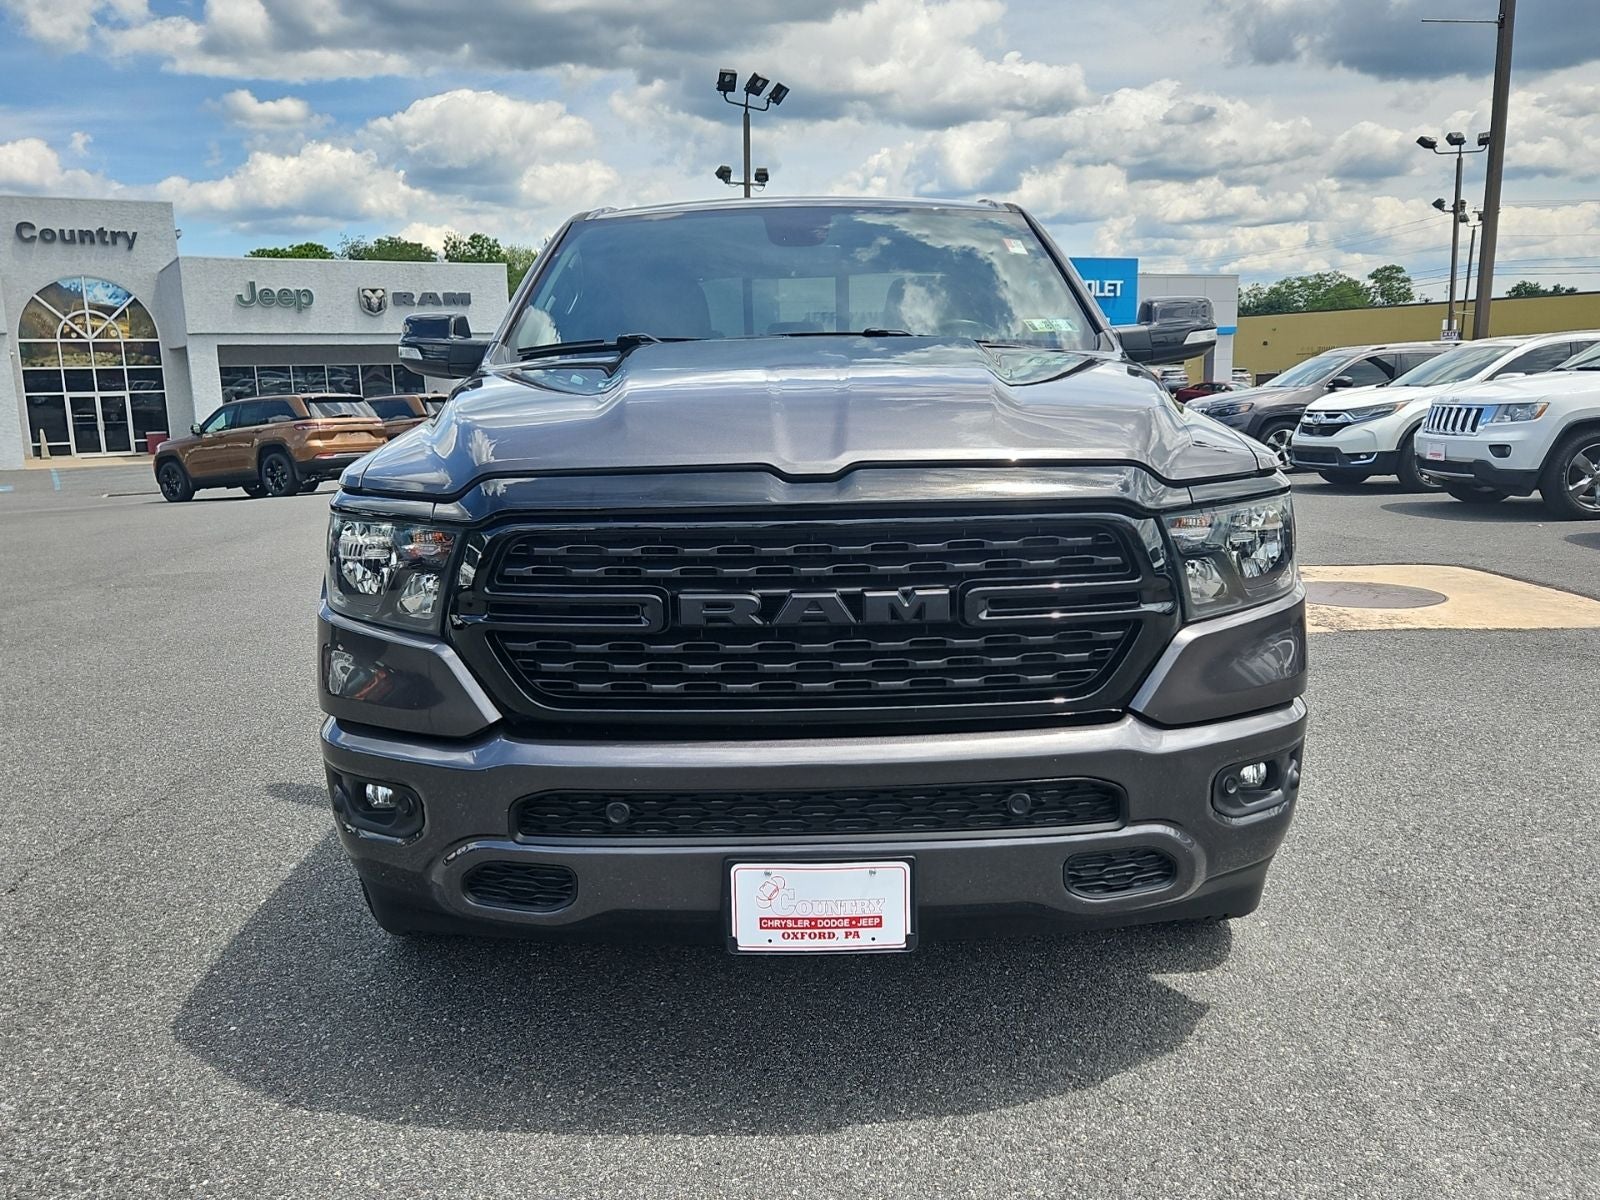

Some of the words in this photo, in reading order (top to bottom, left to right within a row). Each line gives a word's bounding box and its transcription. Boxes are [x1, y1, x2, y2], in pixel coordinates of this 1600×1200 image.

[15, 221, 138, 251] Country
[235, 281, 315, 311] Jeep
[1084, 280, 1124, 297] OLET
[391, 291, 472, 306] RAM
[678, 588, 951, 625] RAM
[761, 919, 810, 928] CHRYSLER
[817, 918, 850, 928] DODGE
[857, 917, 880, 927] JEEP
[781, 931, 839, 941] OXFORD,
[844, 930, 861, 940] PA
